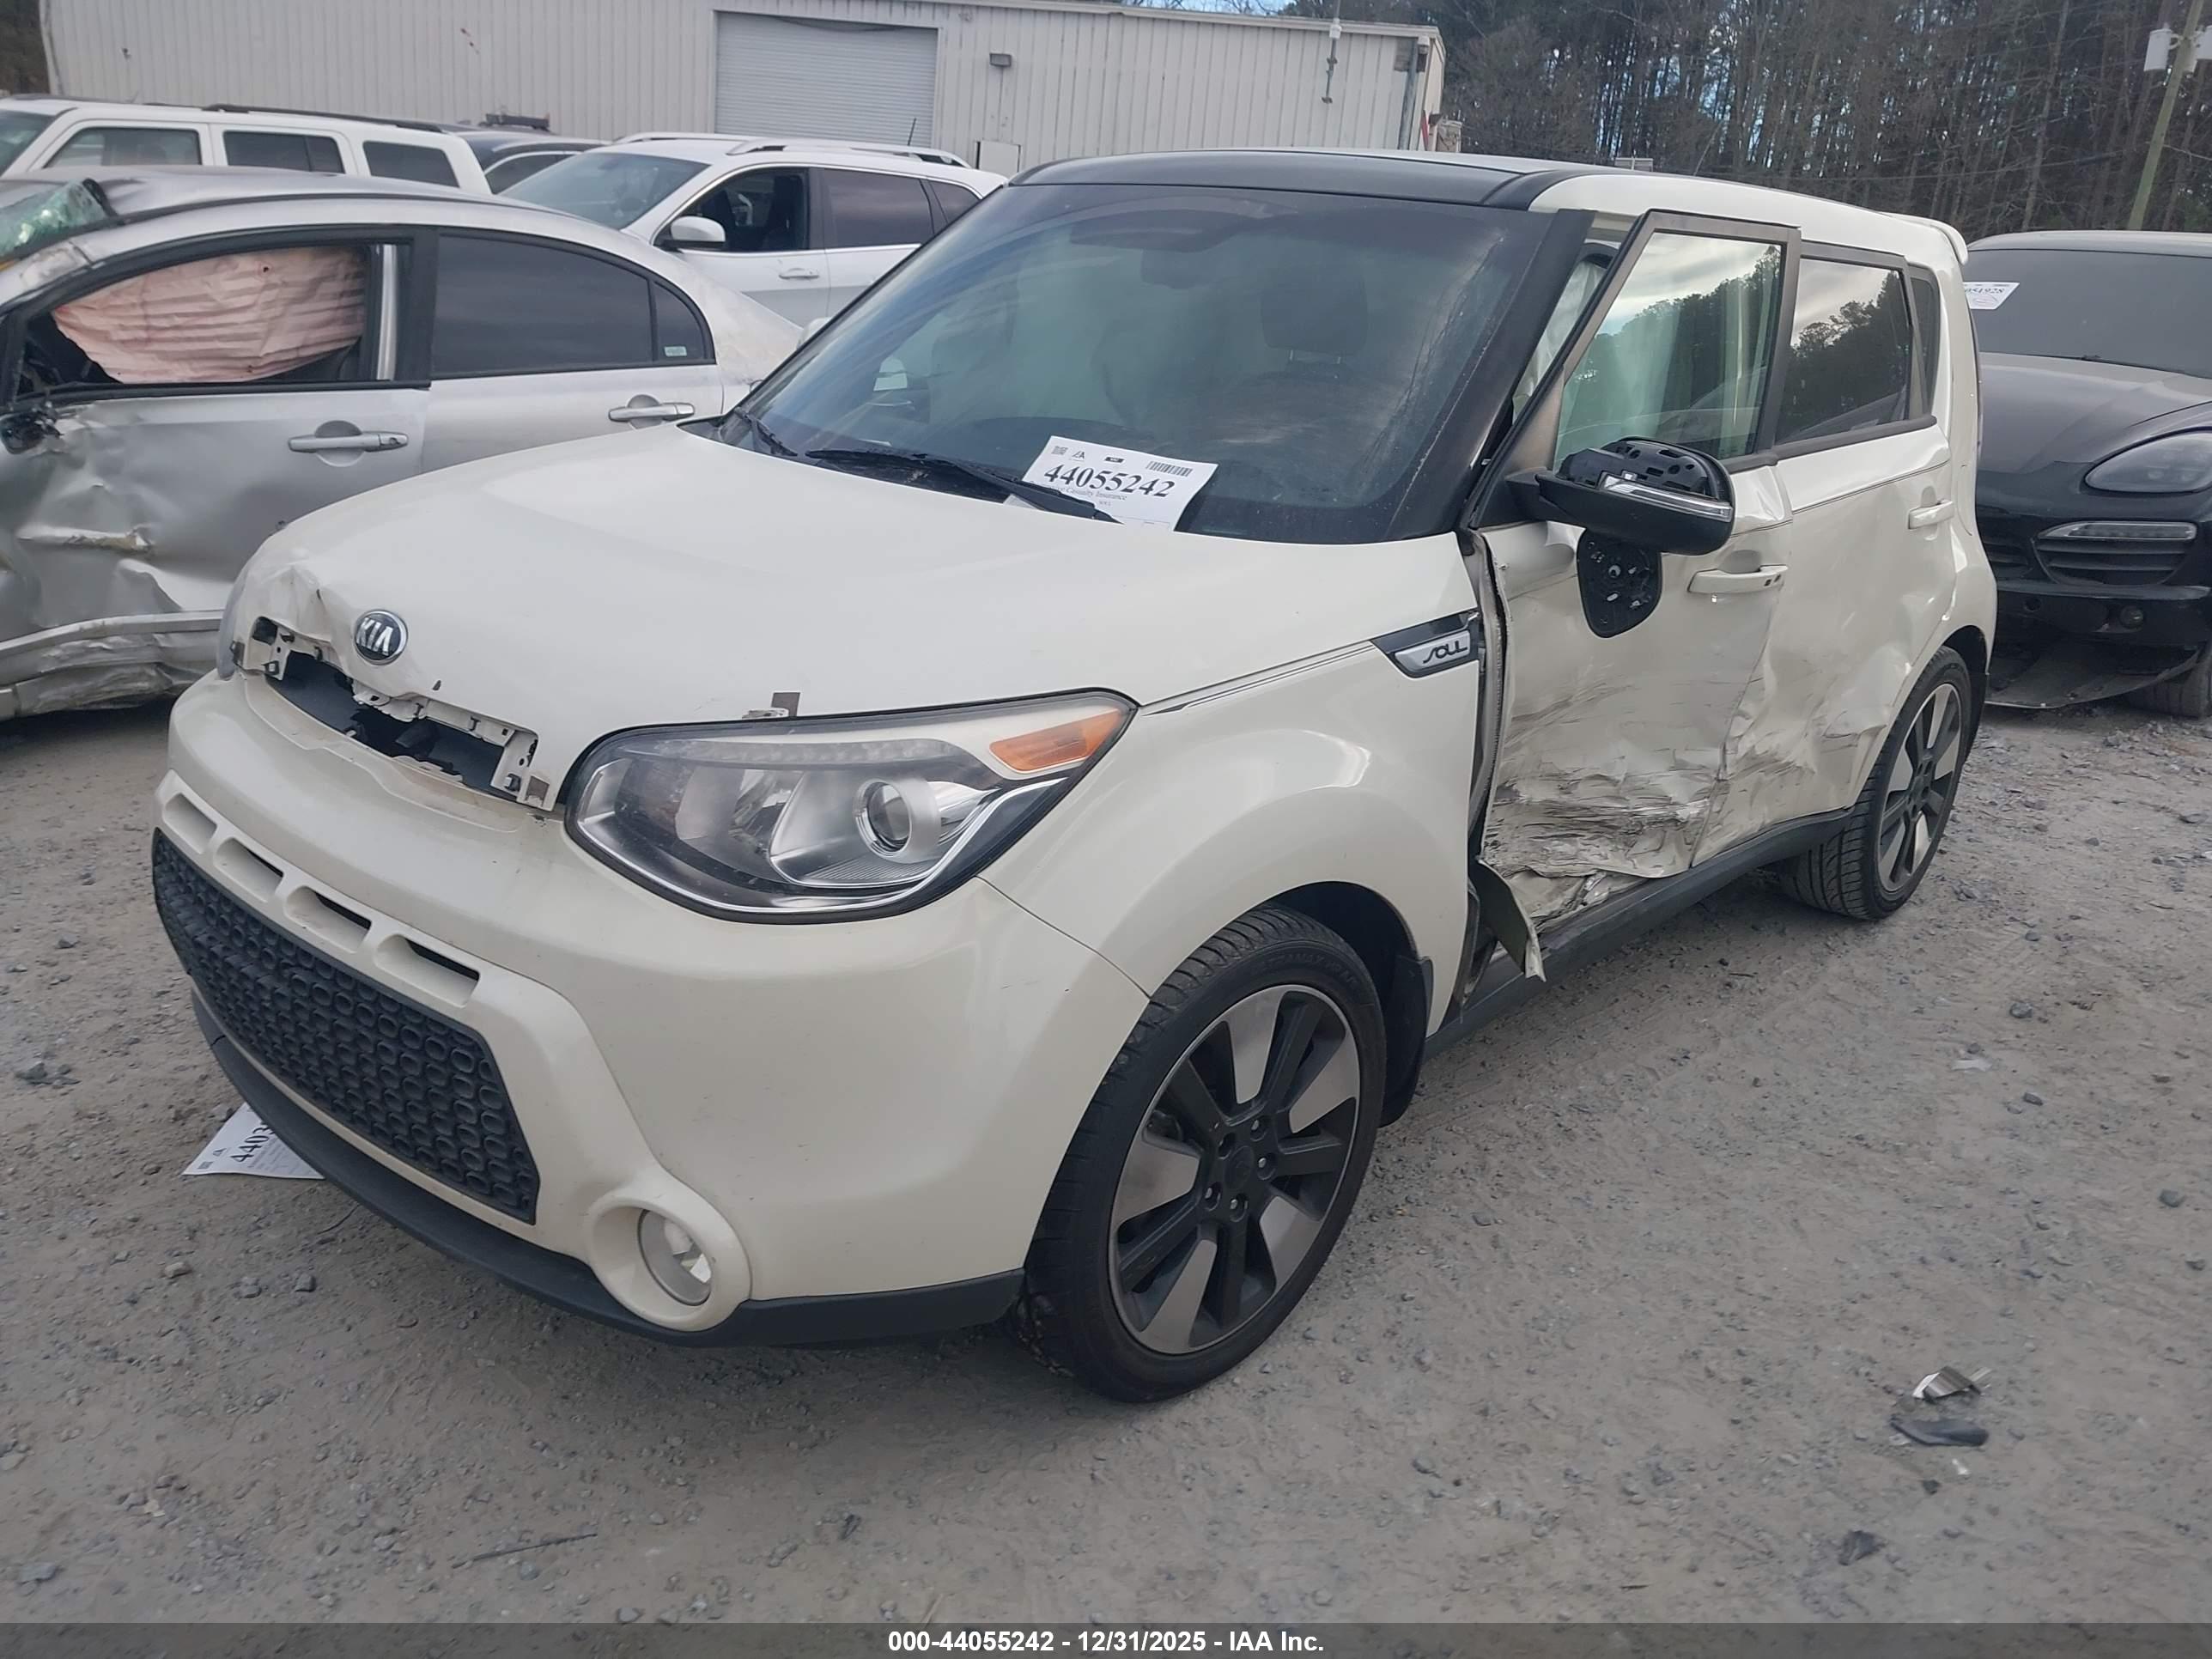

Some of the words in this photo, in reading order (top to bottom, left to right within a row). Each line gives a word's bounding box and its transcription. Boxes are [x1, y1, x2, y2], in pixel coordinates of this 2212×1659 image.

[1044, 464, 1176, 498] 44055242
[356, 617, 394, 657] KIA
[1423, 641, 1468, 663] SOUL
